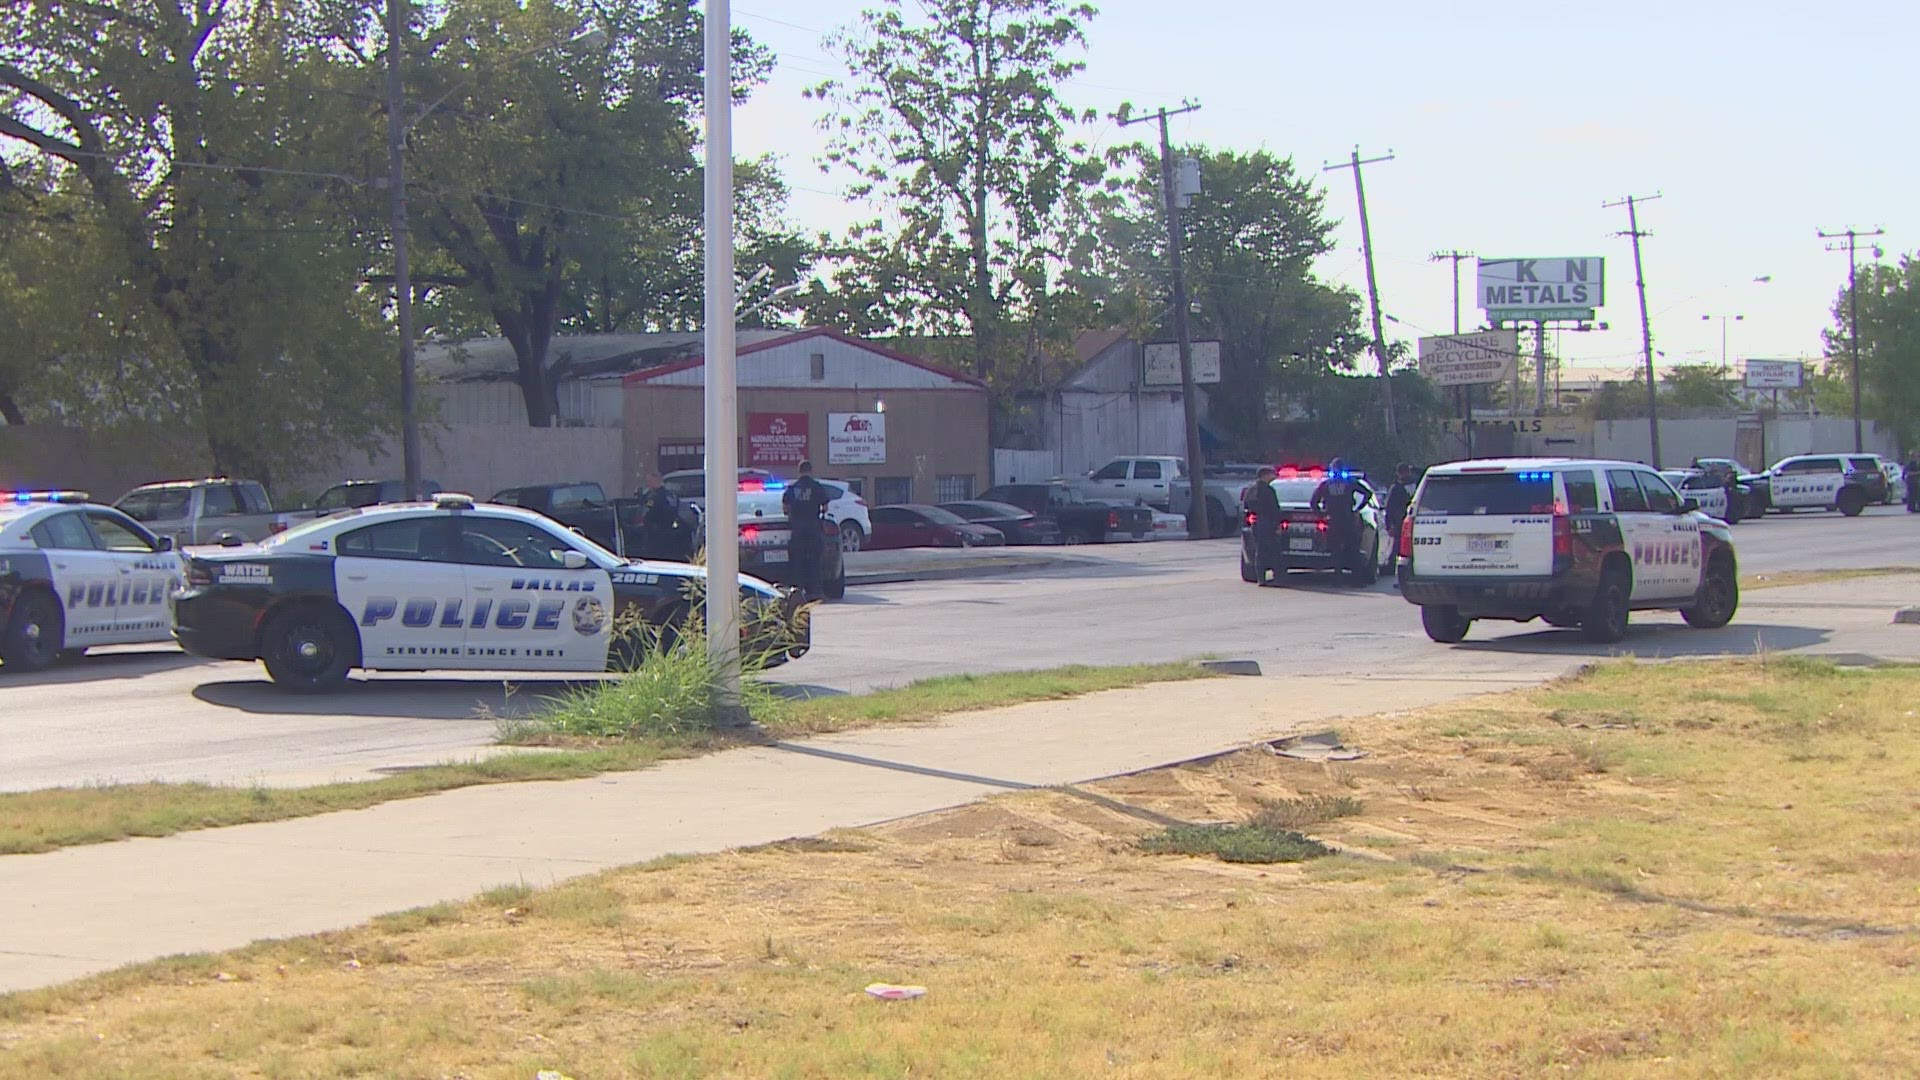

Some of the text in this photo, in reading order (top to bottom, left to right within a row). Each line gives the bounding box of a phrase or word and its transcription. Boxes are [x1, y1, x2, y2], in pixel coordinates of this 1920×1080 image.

[1516, 259, 1587, 283] K N
[1486, 285, 1588, 304] METALS
[1434, 335, 1500, 351] SUNRISE
[1426, 348, 1509, 364] RECYCLING
[1634, 540, 1690, 567] POLICE
[224, 564, 270, 576] WATCH
[218, 575, 273, 584] COMMANDER
[510, 577, 597, 592] DALLAS
[68, 580, 165, 609] POLICE
[360, 597, 566, 630] POLICE
[72, 624, 112, 634] SERVING
[115, 623, 142, 632] SINCE
[386, 646, 565, 657] SERVING SINCE 1881
